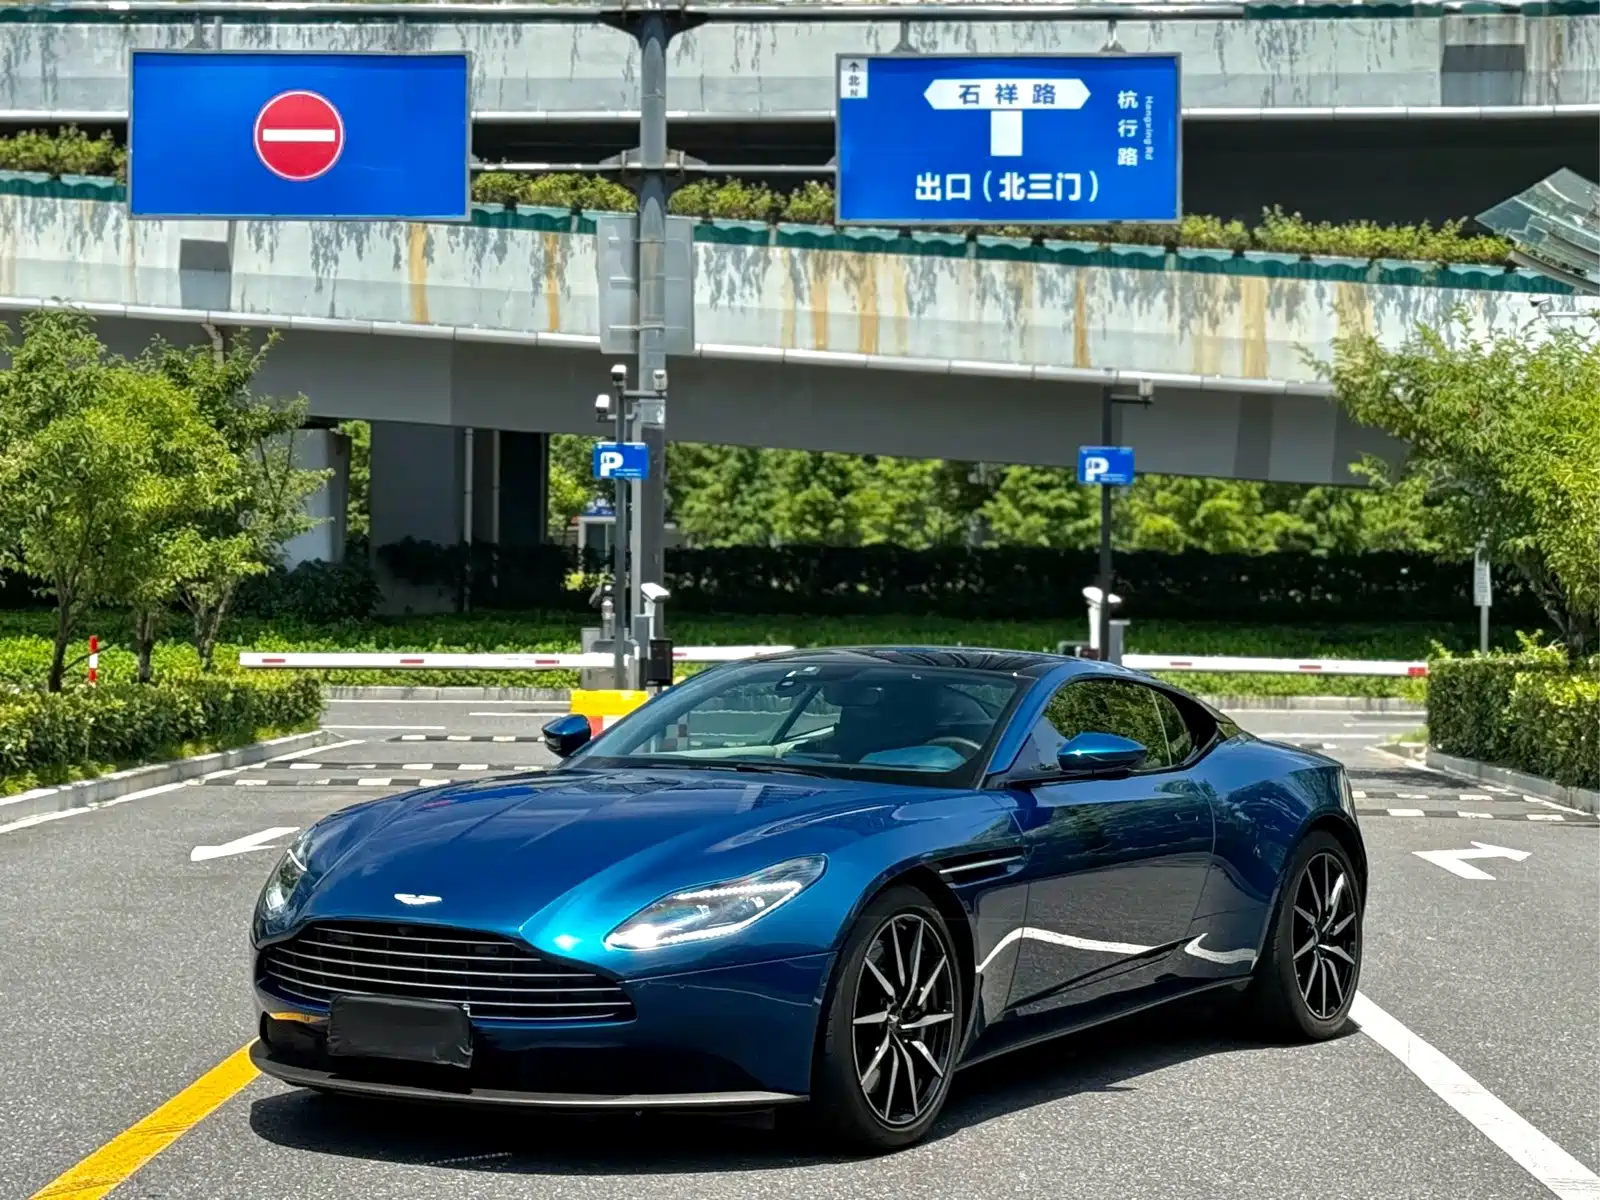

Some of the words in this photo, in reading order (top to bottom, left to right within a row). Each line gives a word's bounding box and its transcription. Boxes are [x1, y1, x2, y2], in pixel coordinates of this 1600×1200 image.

[848, 75, 861, 87] 北
[958, 83, 1057, 105] 石祥路
[1117, 90, 1139, 167] 杭行路
[600, 451, 624, 477] P
[1085, 457, 1110, 482] P
